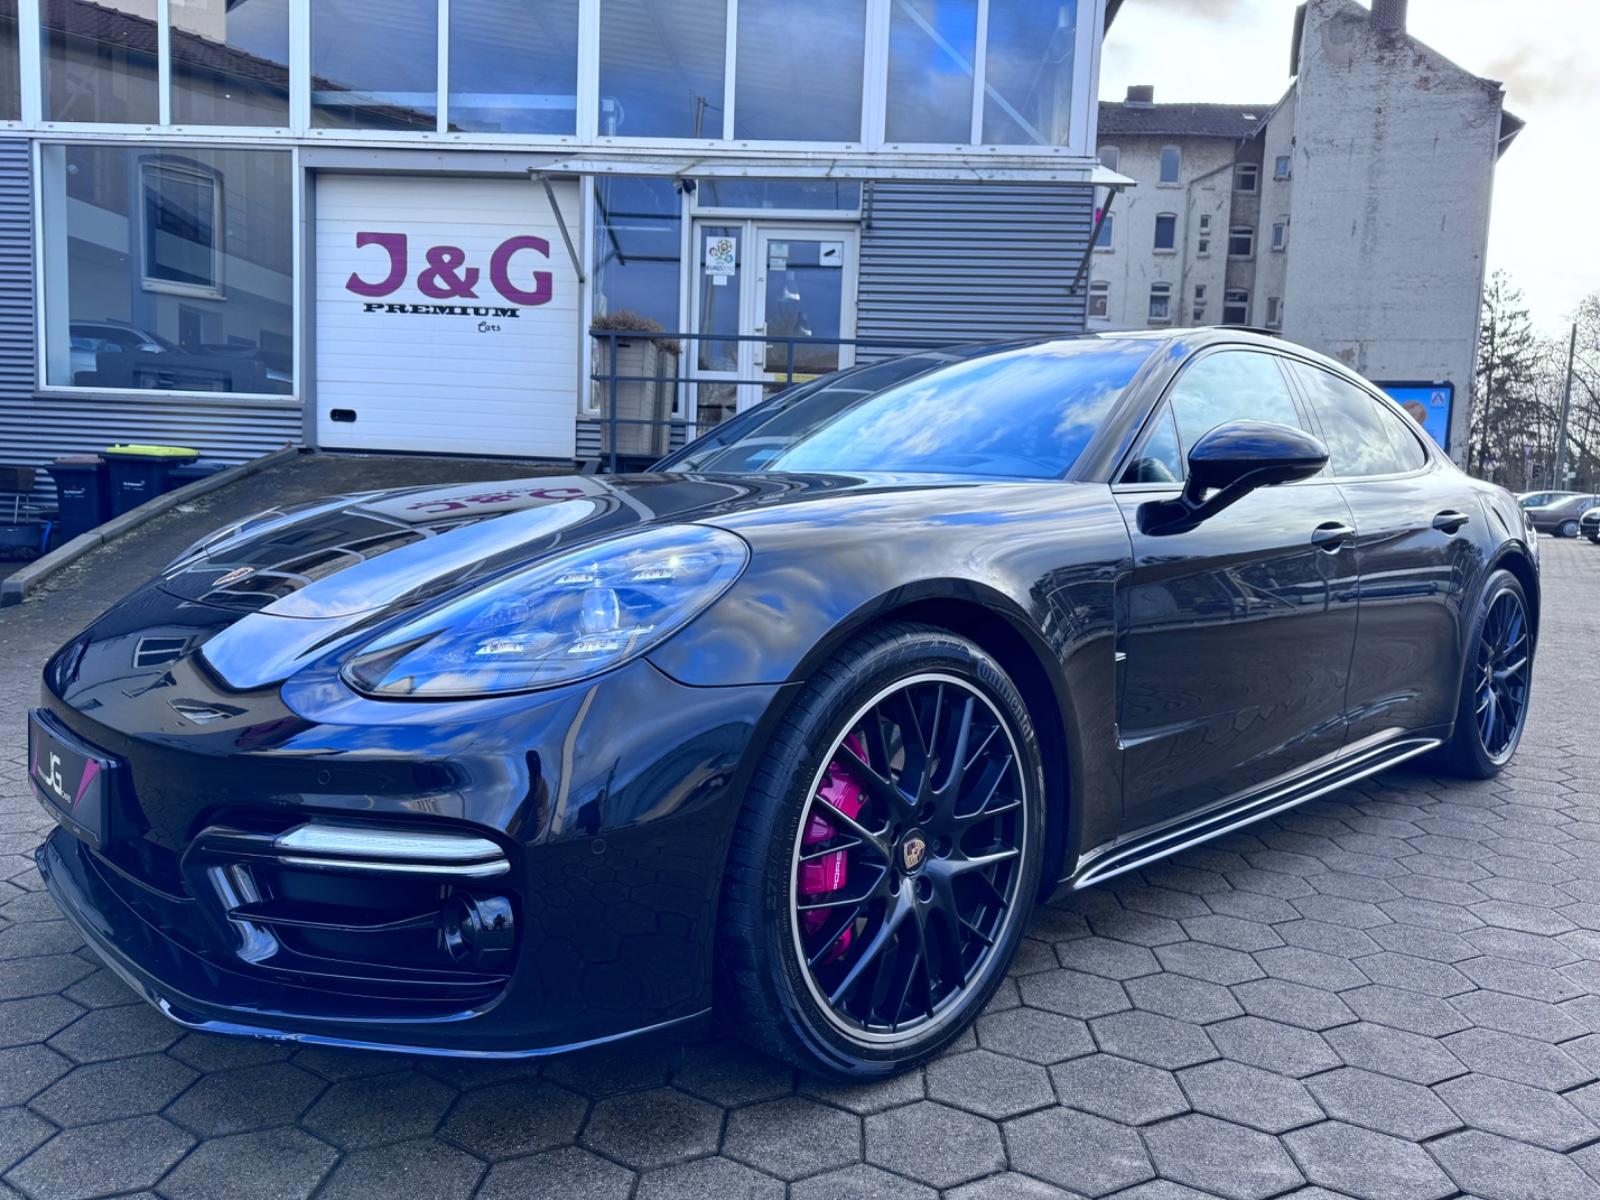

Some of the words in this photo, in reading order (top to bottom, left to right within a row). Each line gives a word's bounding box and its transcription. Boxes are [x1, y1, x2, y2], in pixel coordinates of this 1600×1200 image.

[345, 232, 553, 306] J&G
[363, 303, 520, 318] PREMIUM
[976, 657, 1034, 742] Continental
[833, 850, 842, 890] PORS
